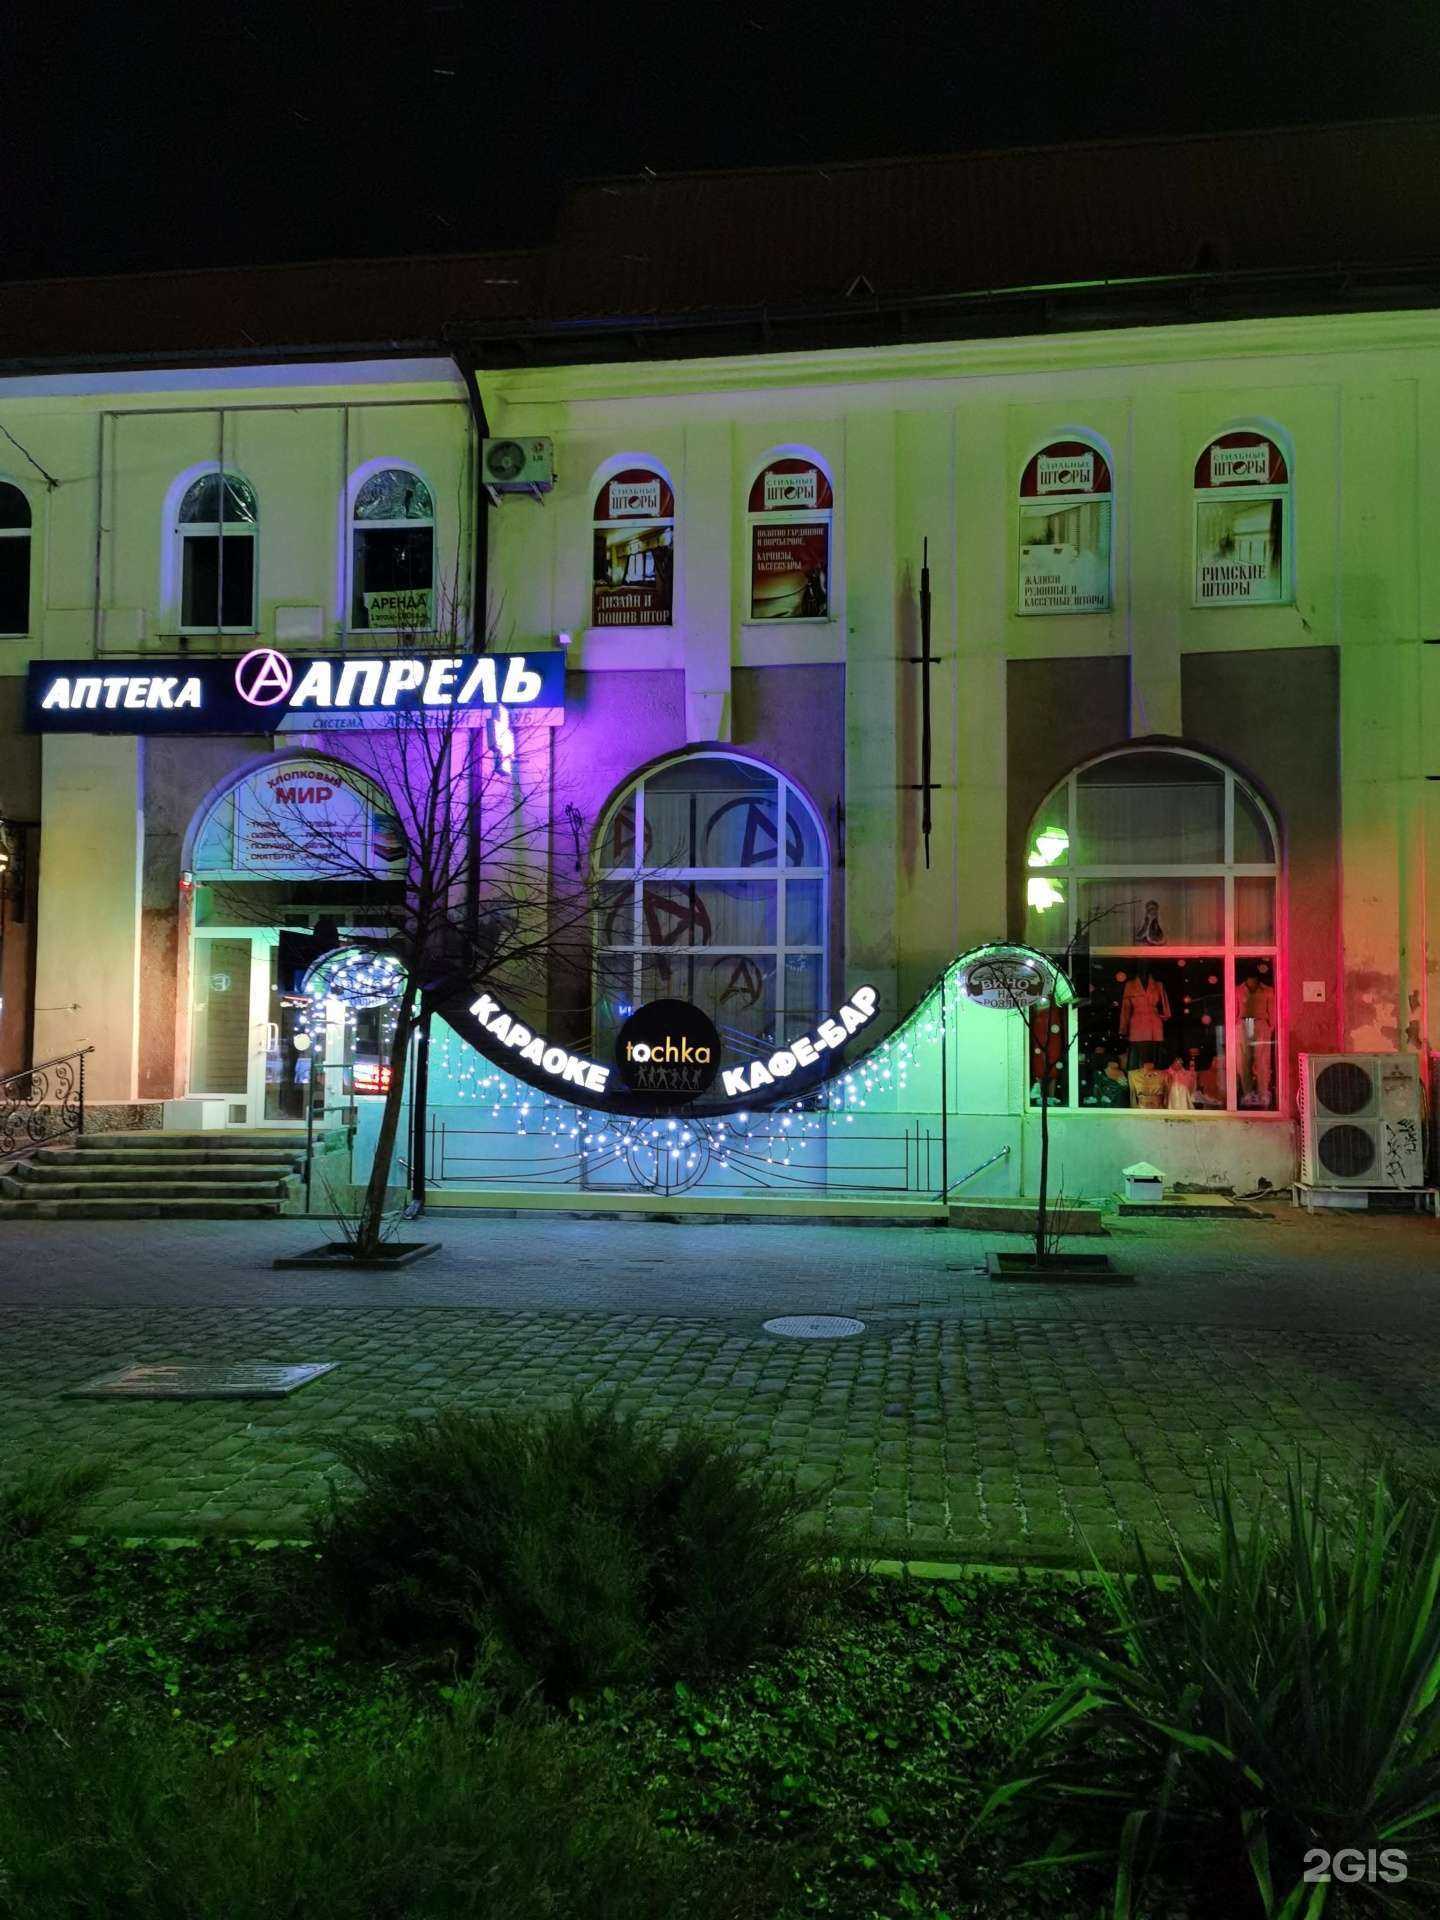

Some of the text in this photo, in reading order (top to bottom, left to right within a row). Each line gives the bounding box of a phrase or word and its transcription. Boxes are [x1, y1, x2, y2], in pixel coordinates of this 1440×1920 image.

[1201, 564, 1265, 581] РИМСКИЕ
[1201, 581, 1251, 598] ШТОРЫ
[371, 593, 428, 610] АРЕНДА
[598, 608, 670, 625] ПОШИВ ШТОР
[42, 677, 202, 709] АПТЕКА
[289, 656, 543, 708] АПРЕЛЬ
[275, 786, 334, 805] МИР
[981, 979, 1030, 991] ВИНО
[469, 984, 880, 1096] КАРАОКЕ КАФЕ-БАР
[626, 1036, 711, 1063] tochka
